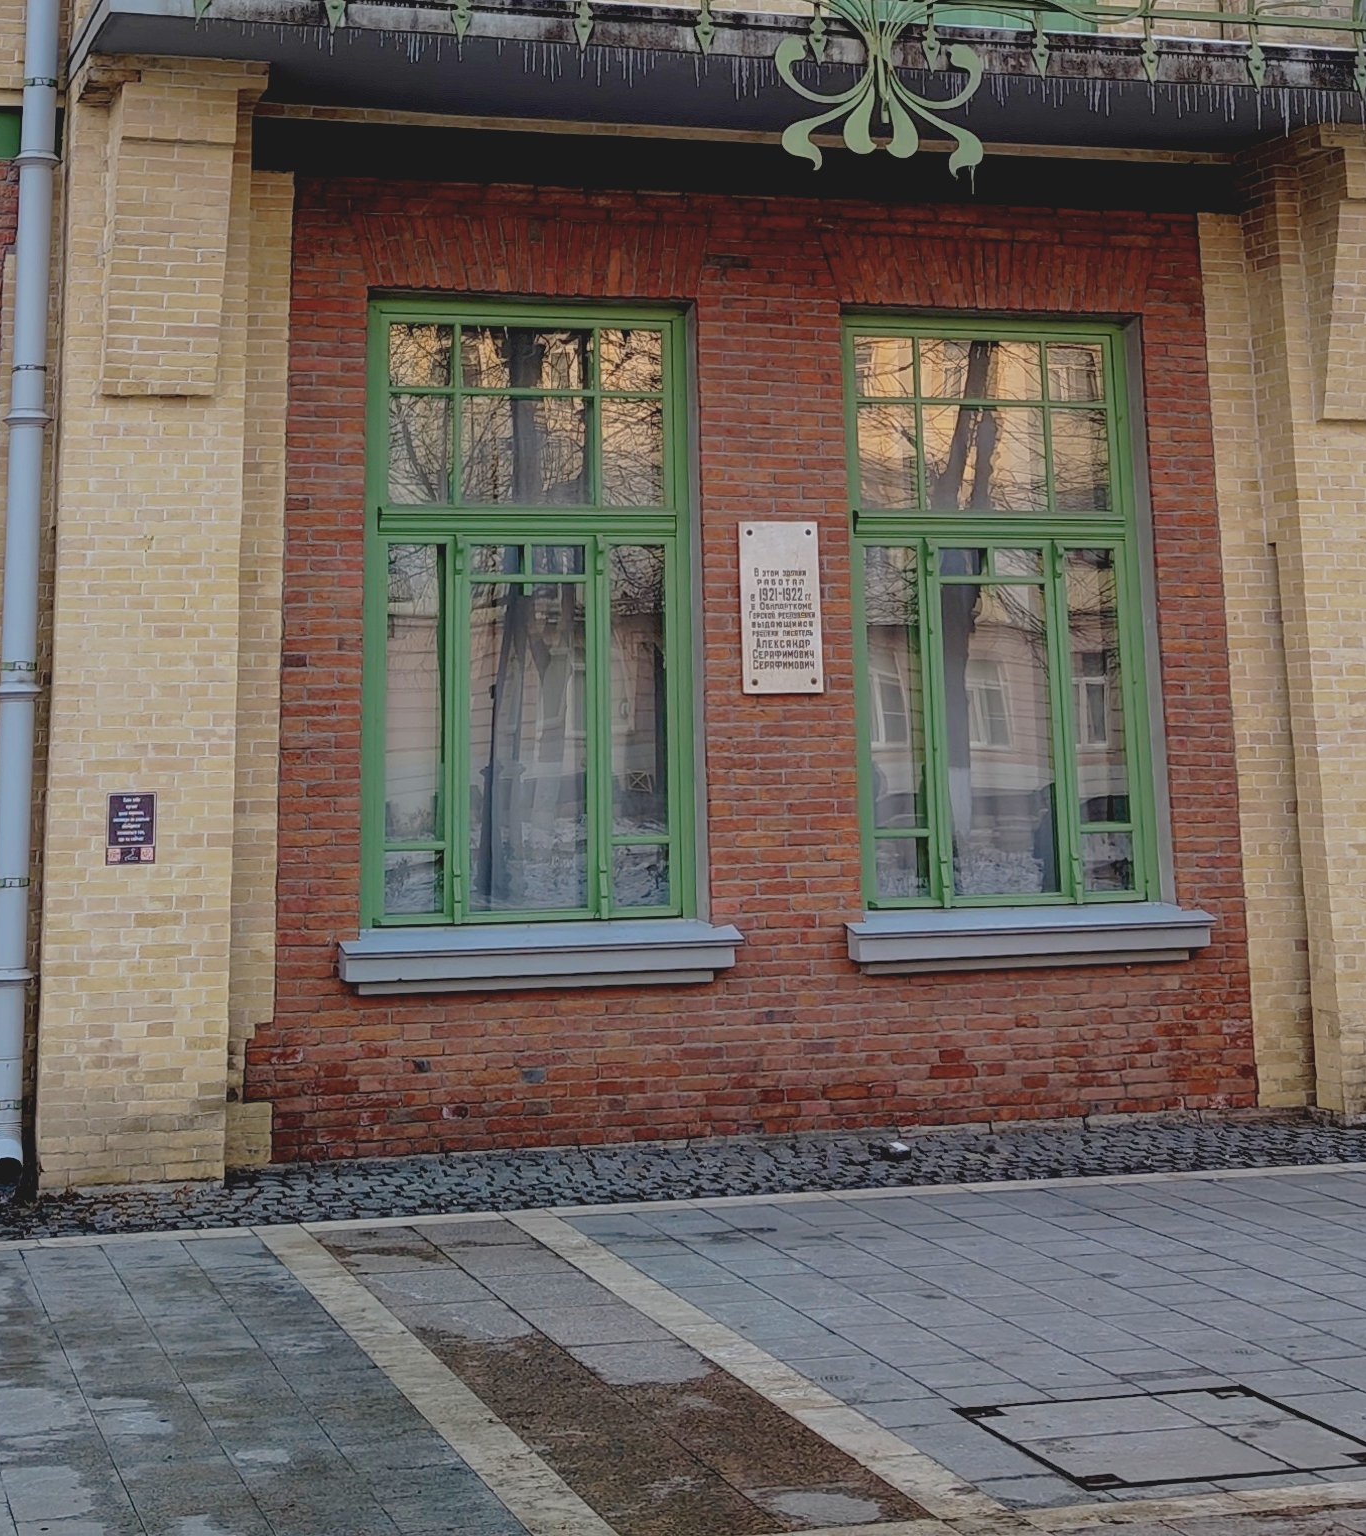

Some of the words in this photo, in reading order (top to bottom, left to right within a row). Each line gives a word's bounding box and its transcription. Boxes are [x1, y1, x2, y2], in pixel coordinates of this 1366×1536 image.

[754, 567, 759, 577] В
[759, 587, 803, 601] 1921-1922
[756, 638, 811, 649] АЛЕКСАНДР
[752, 649, 815, 659] СЕРАФИМОВИЧ
[753, 660, 815, 670] СЕРАФИМОВИЧ
